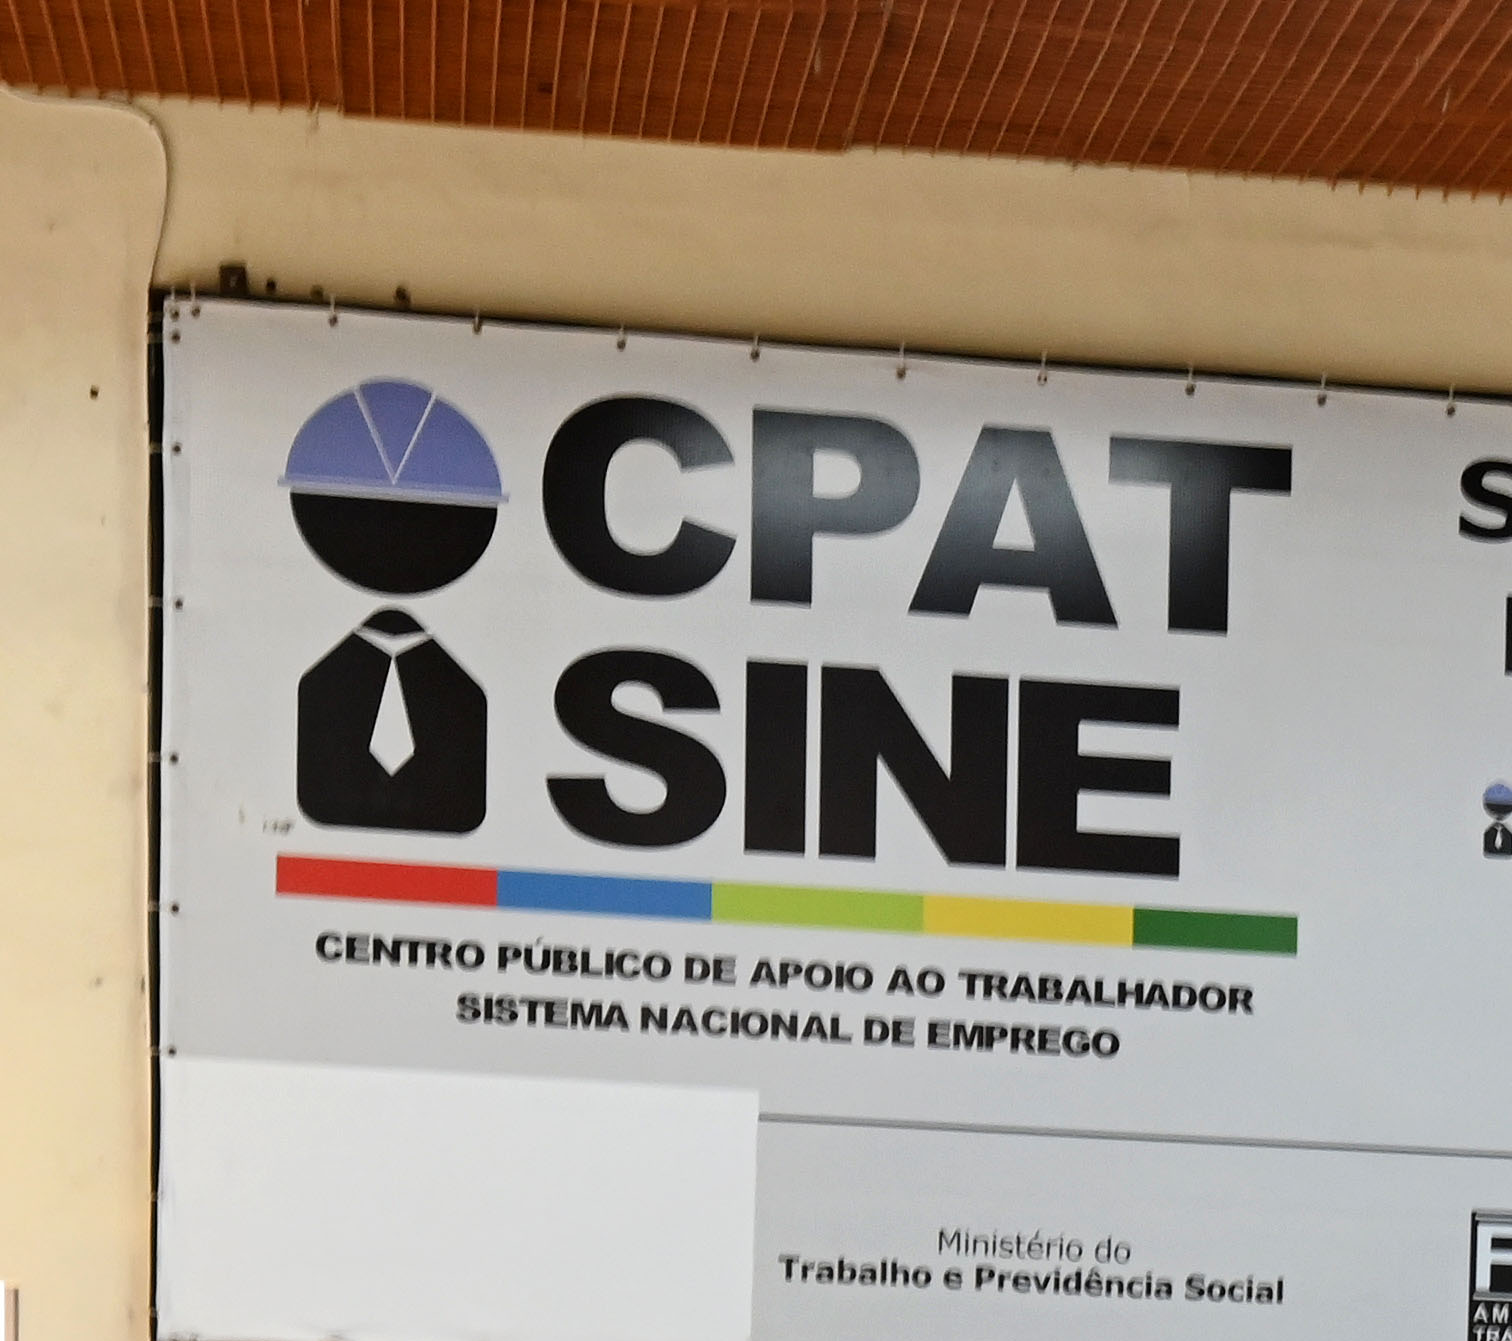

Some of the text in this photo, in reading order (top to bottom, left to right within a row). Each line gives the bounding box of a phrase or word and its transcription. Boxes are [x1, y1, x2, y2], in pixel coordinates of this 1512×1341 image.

[542, 395, 1292, 635] CPAT
[546, 649, 1180, 878] SINE
[315, 929, 1255, 1016] CENTRO PÚBLICO DE APOIO AO TRABALHADOR
[456, 992, 1121, 1060] SISTEMA NACIONAL DE EMPREGO
[778, 1253, 1285, 1304] Trabalho e Previdência Social
[938, 1227, 1131, 1265] Ministério do
